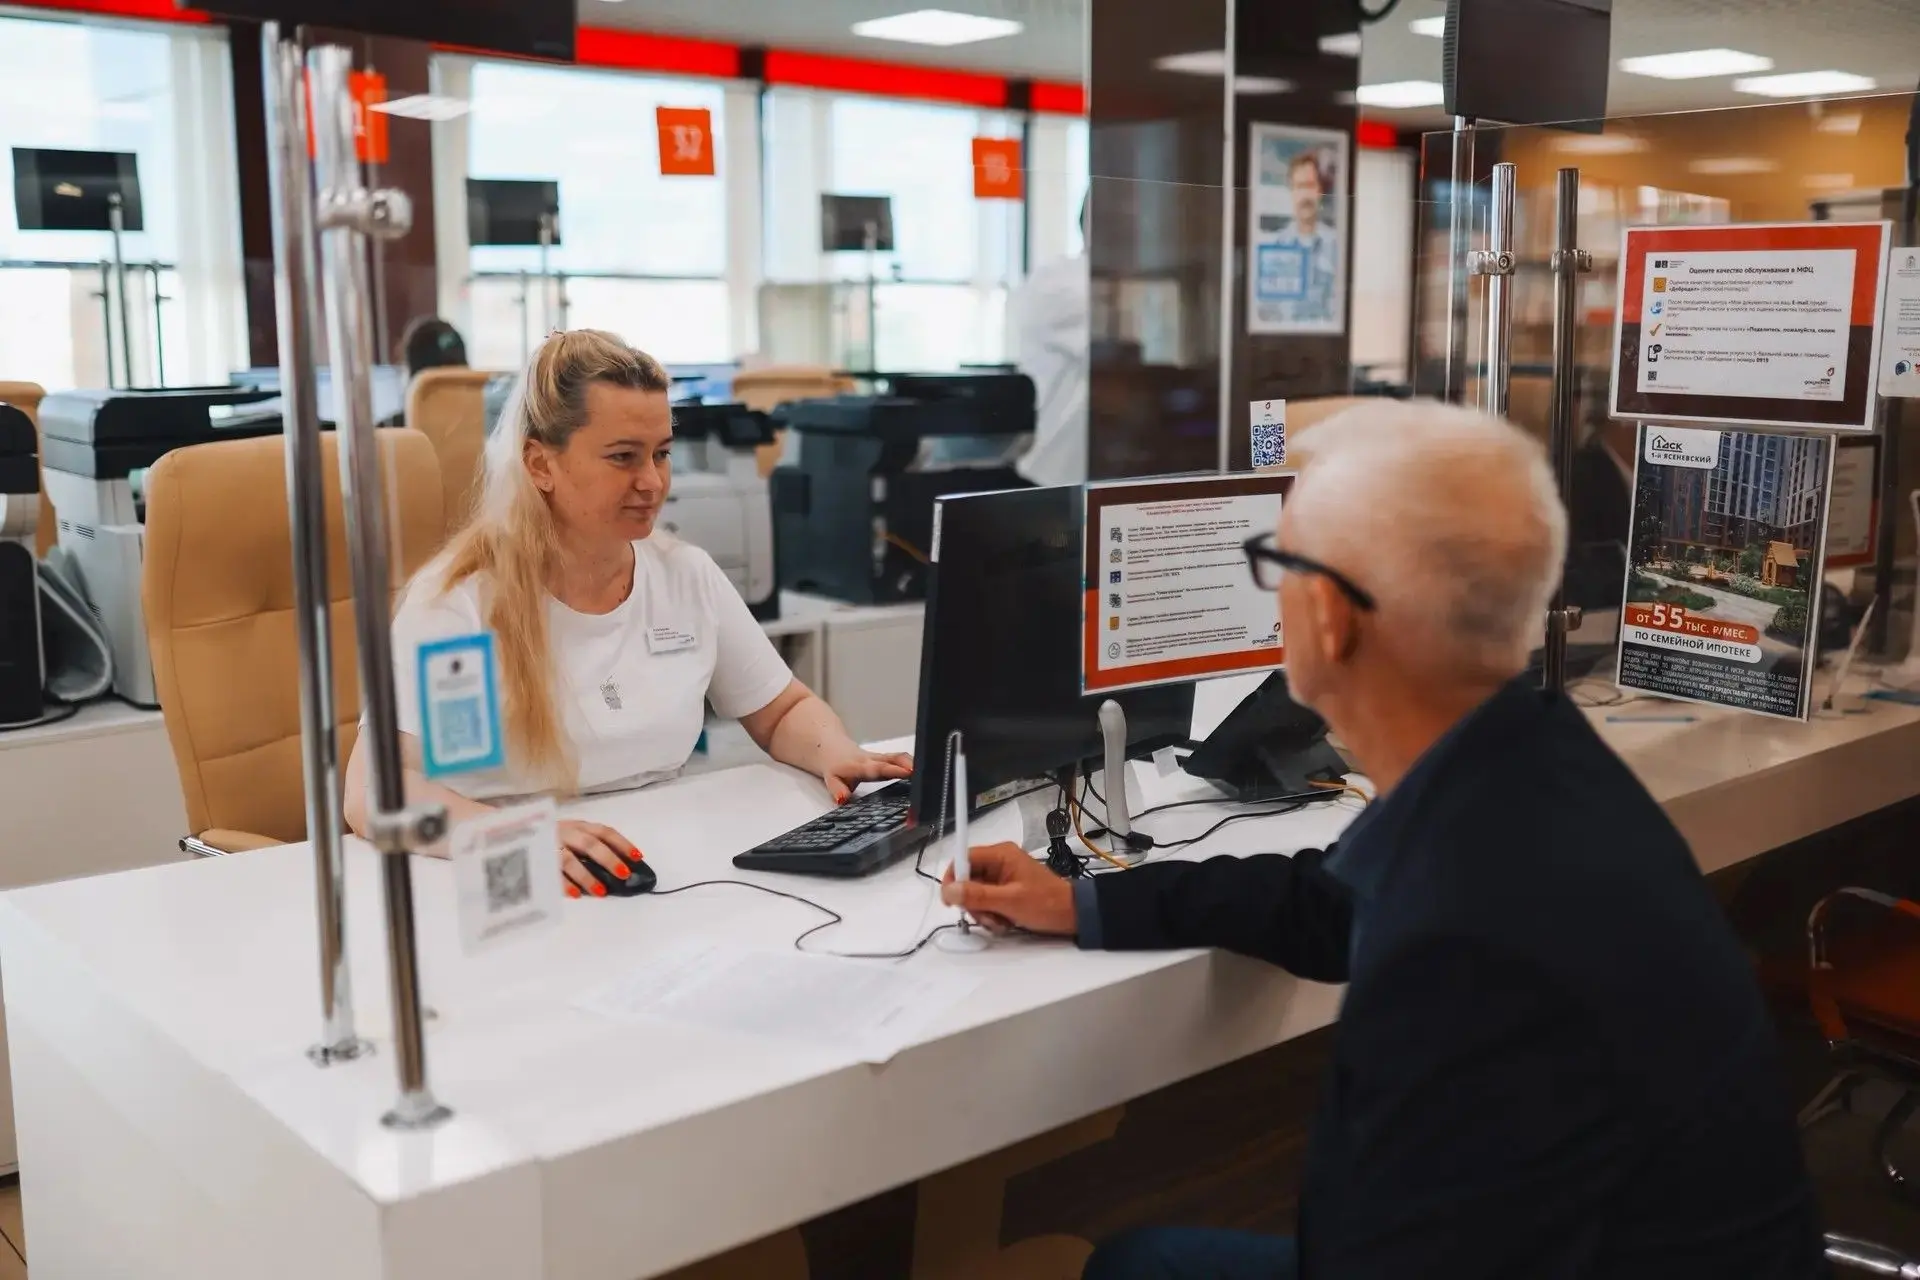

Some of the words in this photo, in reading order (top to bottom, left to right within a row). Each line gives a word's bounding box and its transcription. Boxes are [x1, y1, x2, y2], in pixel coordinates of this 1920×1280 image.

[1689, 267, 1715, 275] Оцените
[1744, 267, 1790, 275] обслуживания
[1796, 266, 1814, 274] МФЦ
[1663, 453, 1712, 464] ЯСЕНЕВСКИЙ
[1636, 613, 1650, 624] ОТ
[1652, 604, 1684, 629] 55
[1685, 620, 1710, 634] ТЫС.
[1635, 630, 1649, 641] ПО
[1650, 632, 1704, 650] СЕМЕЙНОЙ
[1706, 642, 1752, 658] ИПОТЕКЕ
